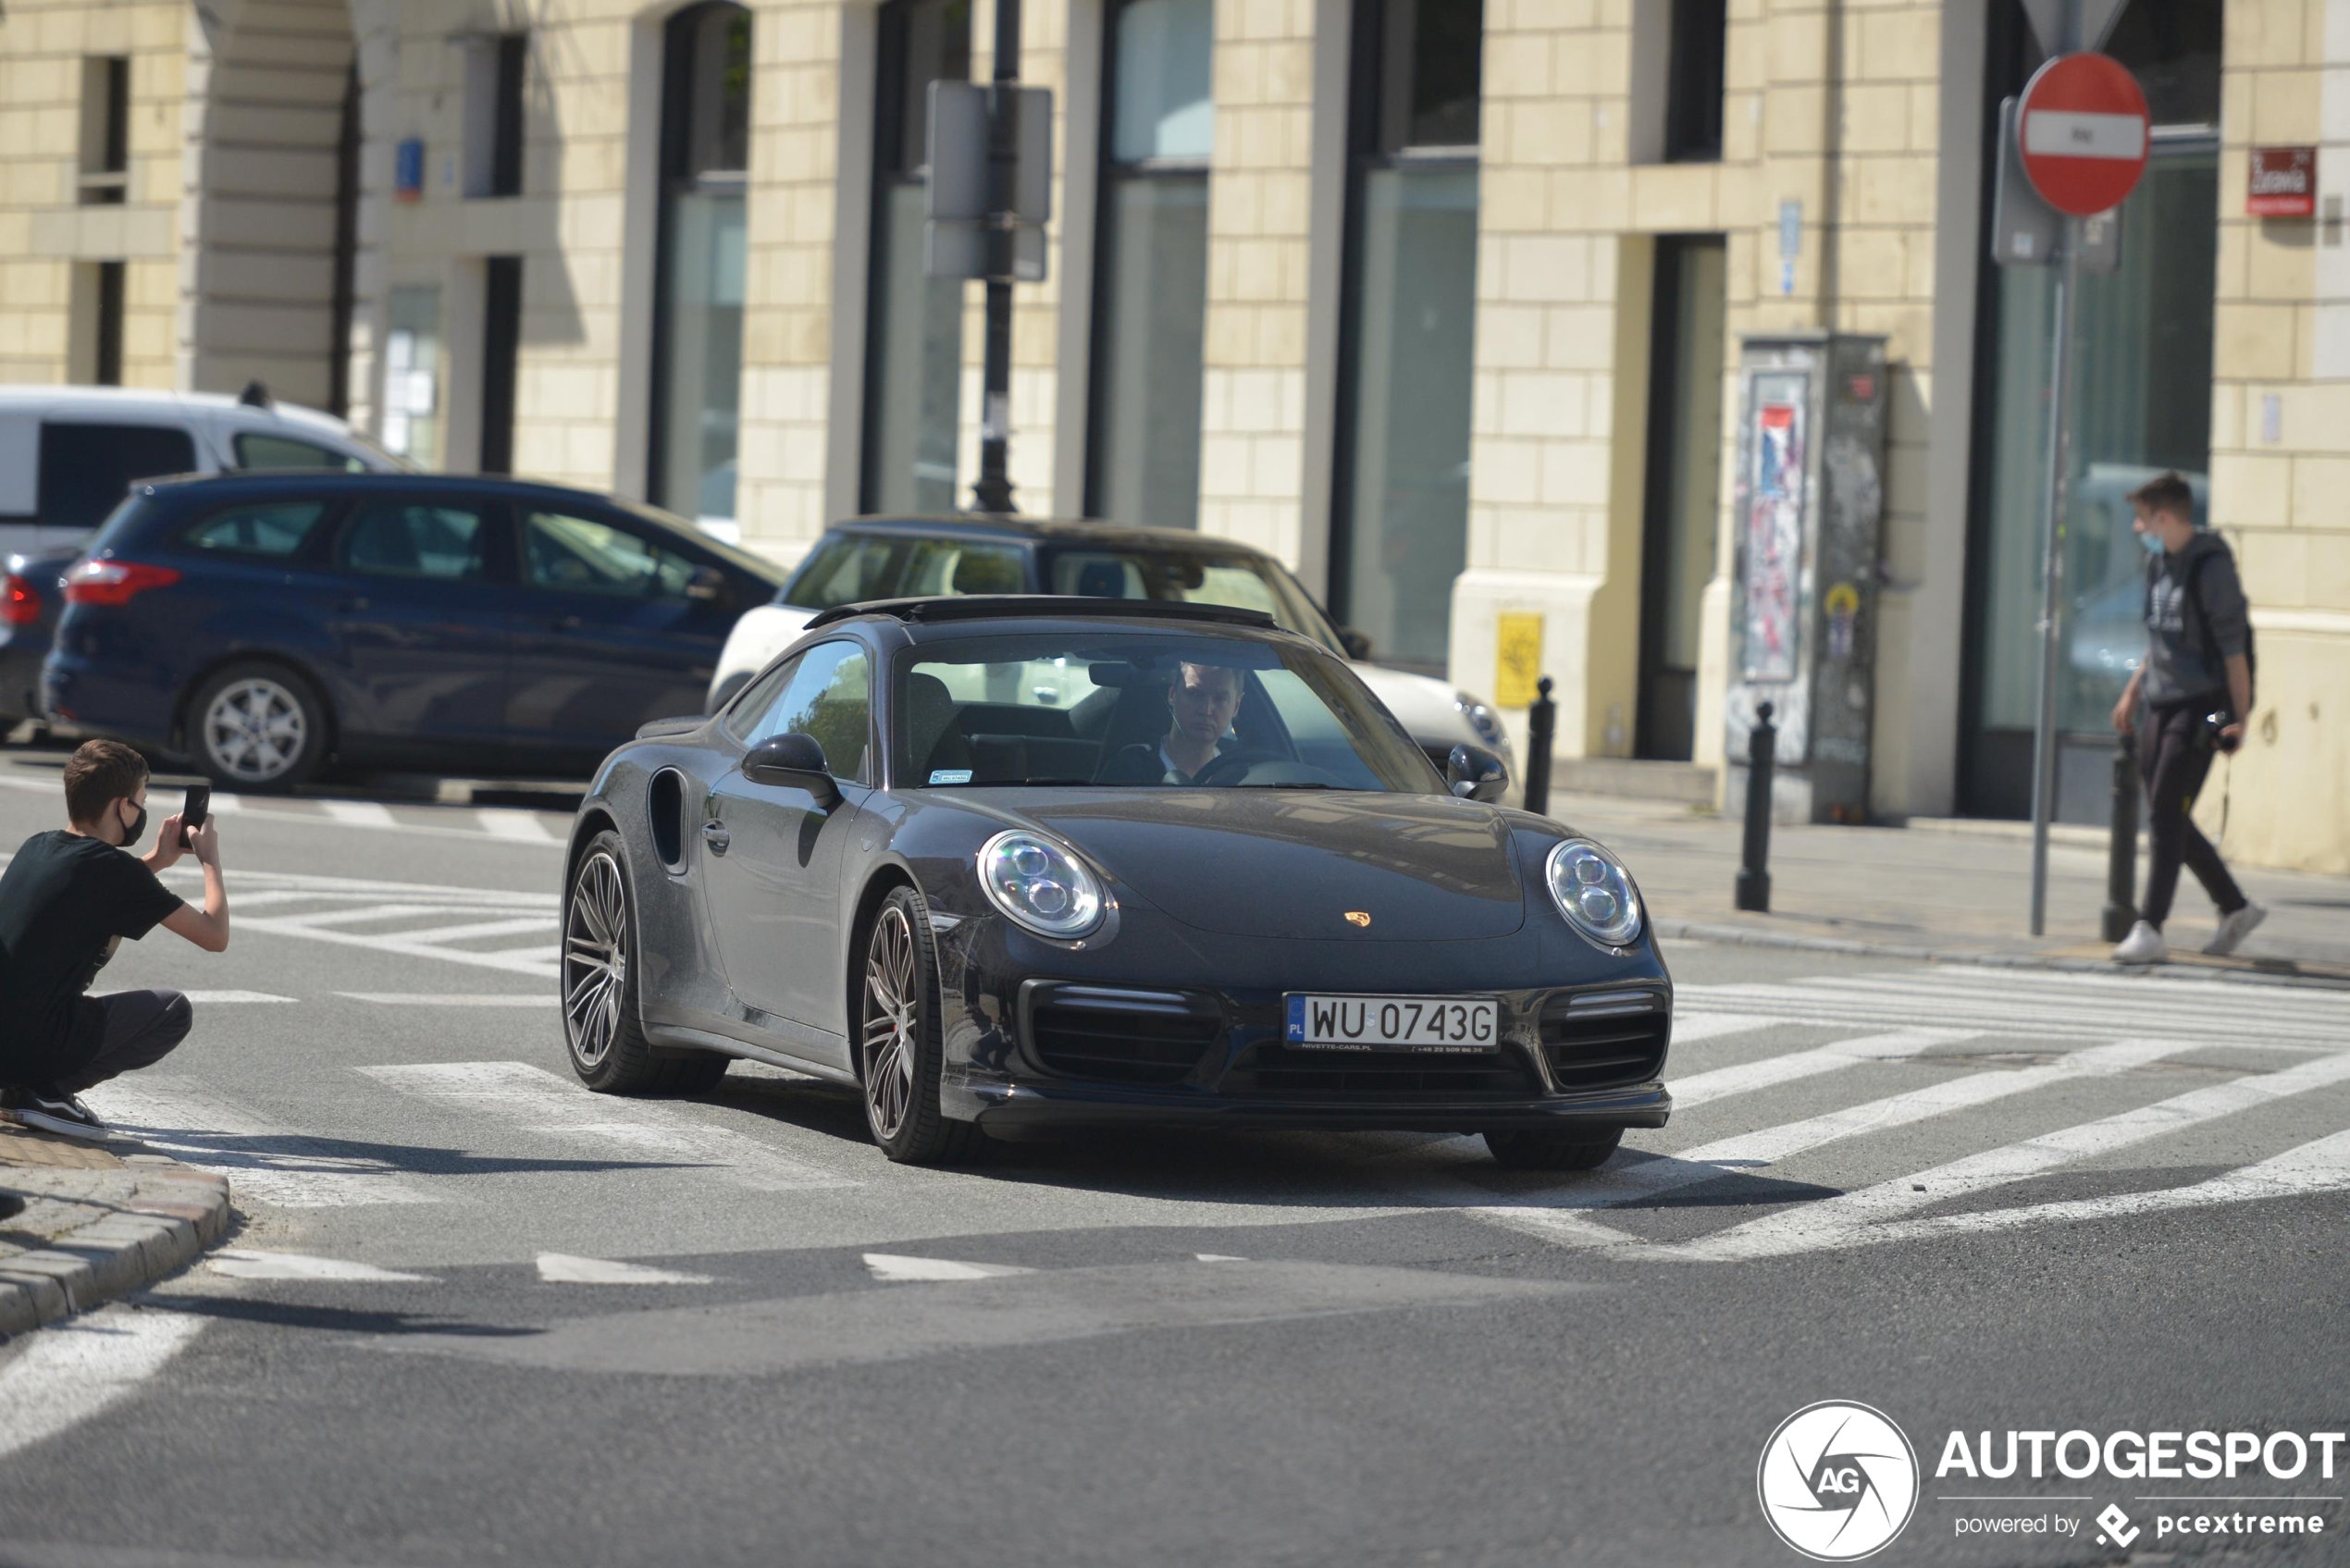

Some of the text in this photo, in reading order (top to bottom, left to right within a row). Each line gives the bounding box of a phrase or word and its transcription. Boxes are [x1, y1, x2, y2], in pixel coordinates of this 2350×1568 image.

[1313, 1001, 1491, 1042] WU 0743G
[1290, 1024, 1303, 1034] PL
[1302, 1043, 1372, 1051] NIVETTE-CARS.PL
